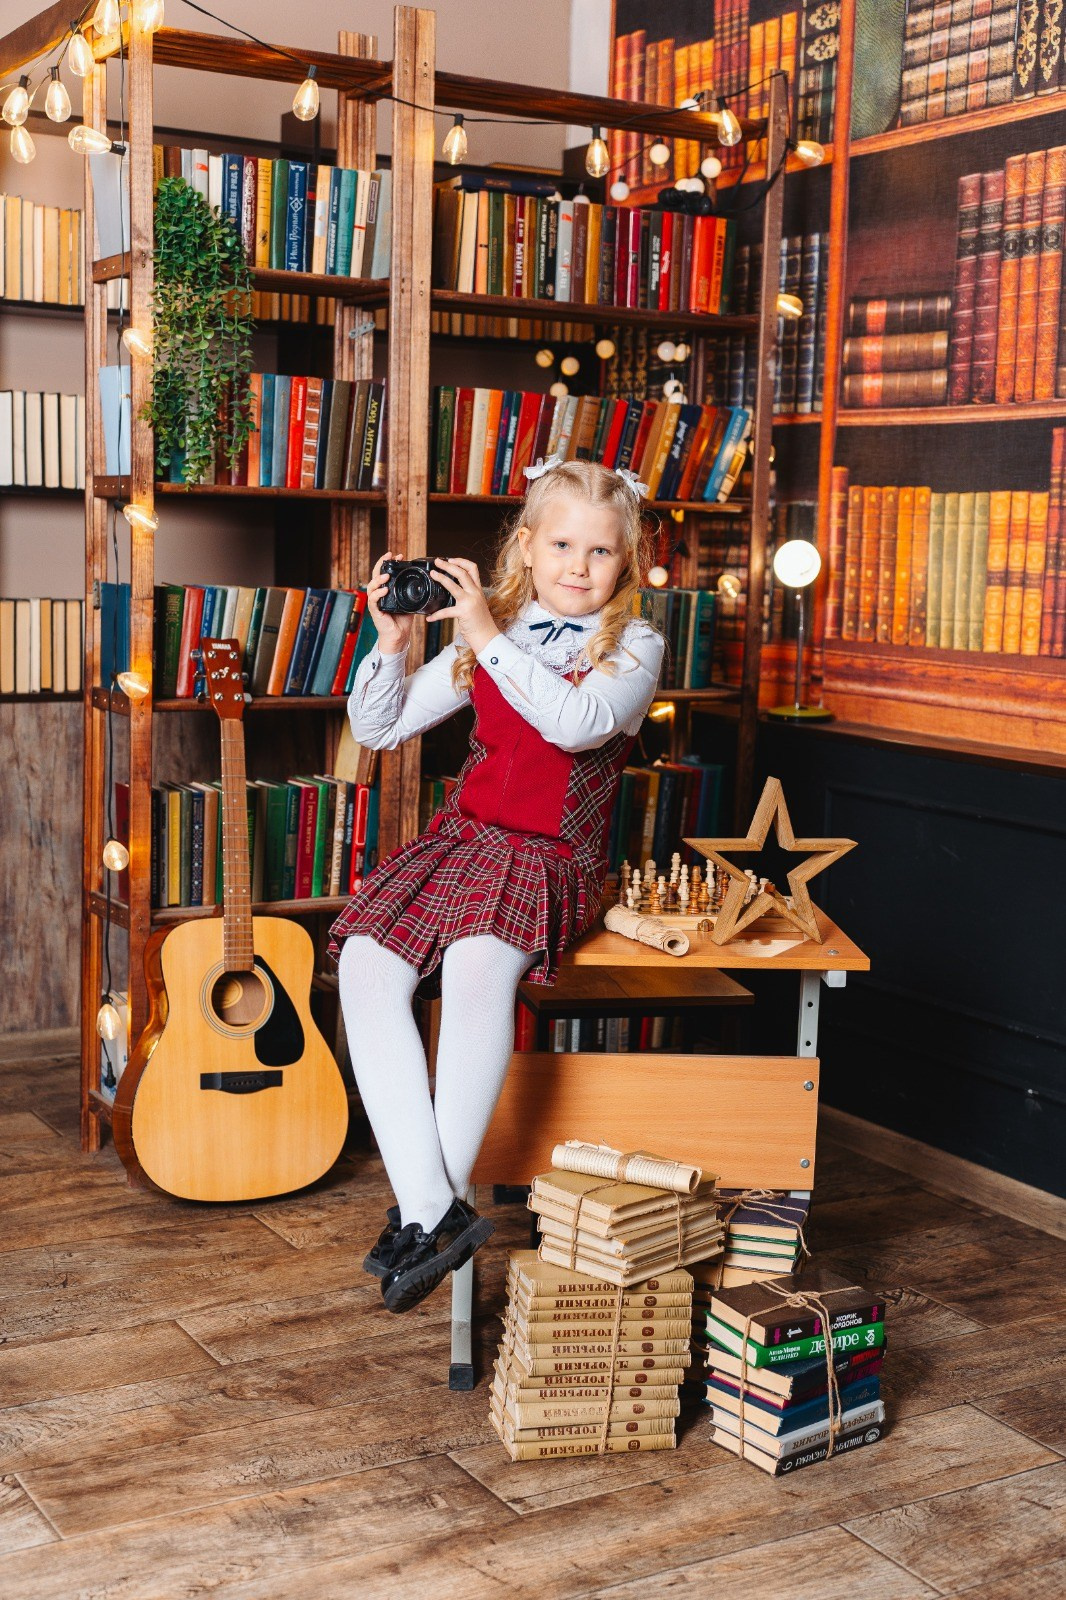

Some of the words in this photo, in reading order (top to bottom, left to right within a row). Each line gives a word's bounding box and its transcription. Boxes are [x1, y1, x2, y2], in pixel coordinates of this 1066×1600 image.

[229, 189, 238, 217] МАЙН
[555, 1298, 616, 1309] ГОРЬКИЙ
[553, 1311, 612, 1321] ГОРЬКИЙ
[836, 1312, 858, 1323] ЖОРЖ
[552, 1329, 613, 1340] ГОРЬКИЙ
[552, 1344, 613, 1356] ГОРЬКИЙ
[809, 1332, 860, 1356] деире
[544, 1375, 605, 1387] ГОРЬКИЙ
[539, 1389, 599, 1400] ГОРЬКИЙ
[537, 1426, 597, 1439] ГОРЬКИЙ
[792, 1429, 829, 1450] ВИКТОР
[539, 1444, 599, 1457] ГОРЬКИЙ
